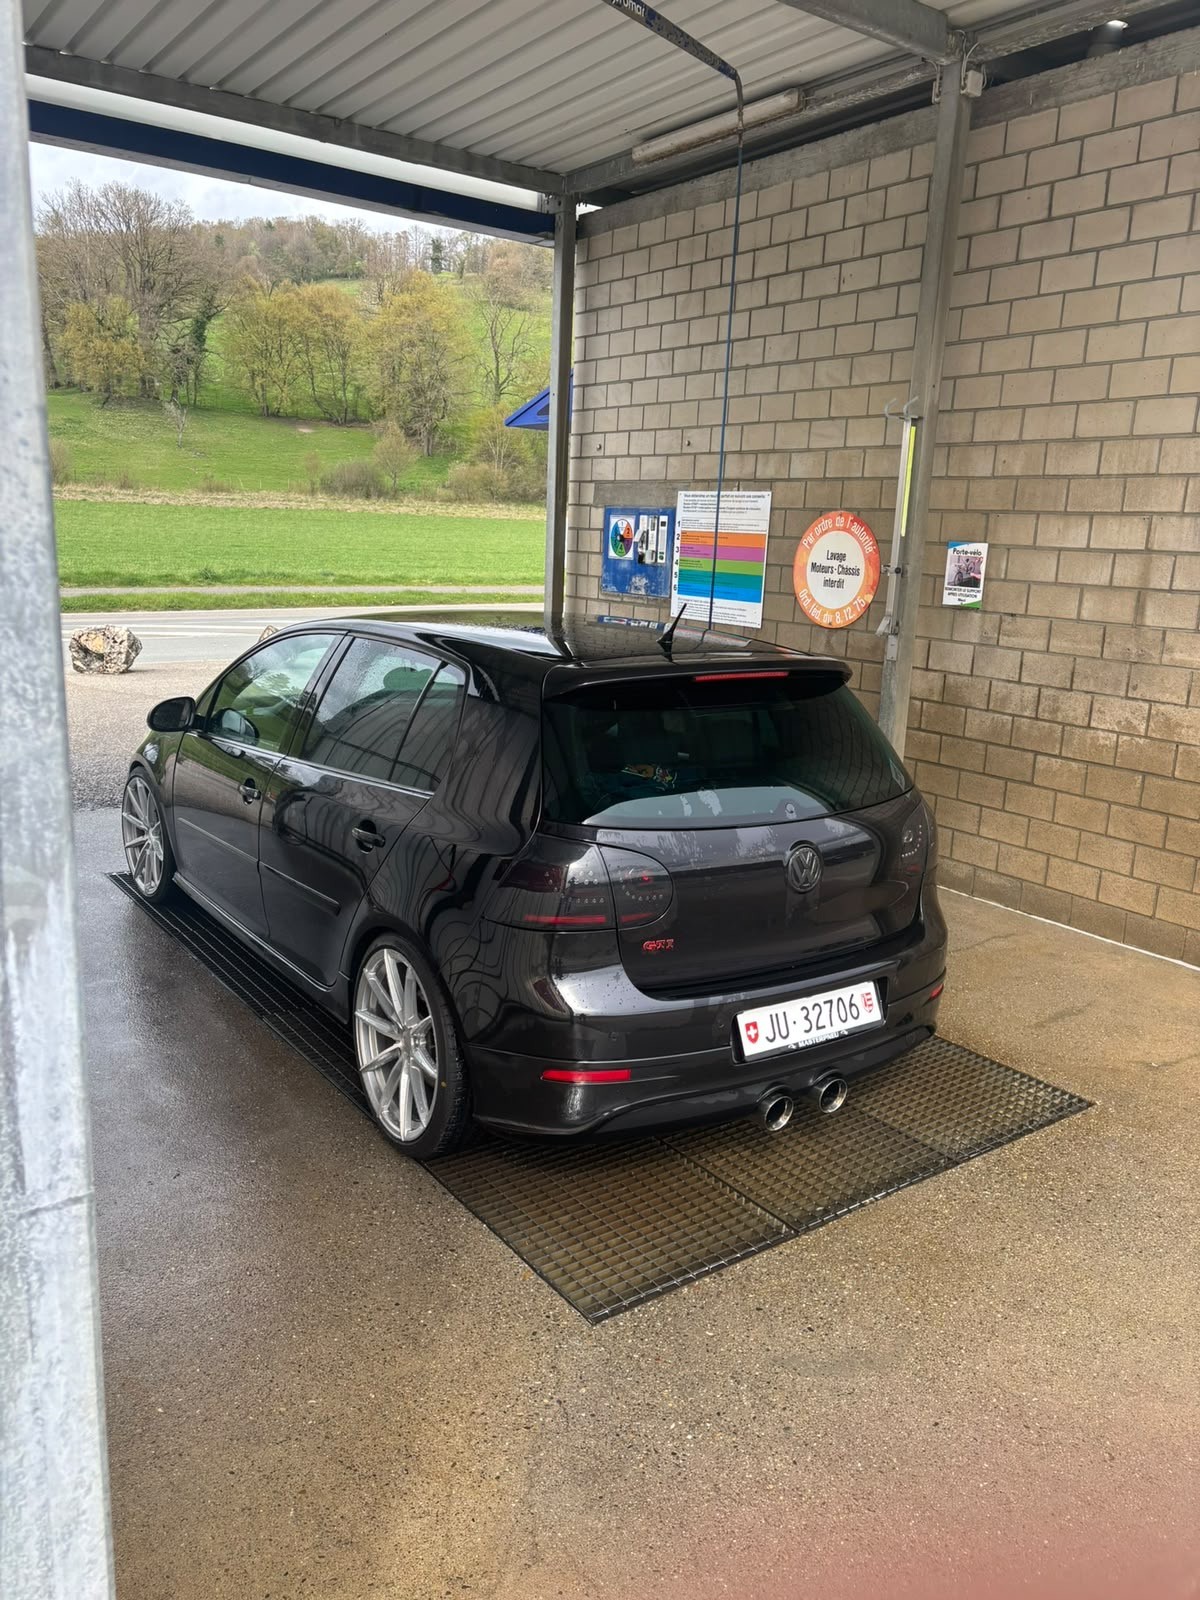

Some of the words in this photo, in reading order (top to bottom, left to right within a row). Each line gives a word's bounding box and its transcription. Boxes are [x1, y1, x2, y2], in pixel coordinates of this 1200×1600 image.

[802, 532, 814, 550] Par
[814, 517, 832, 536] ordre
[836, 516, 844, 527] de
[826, 550, 847, 562] Lavage
[823, 577, 845, 589] interdit
[642, 938, 674, 950] GTI
